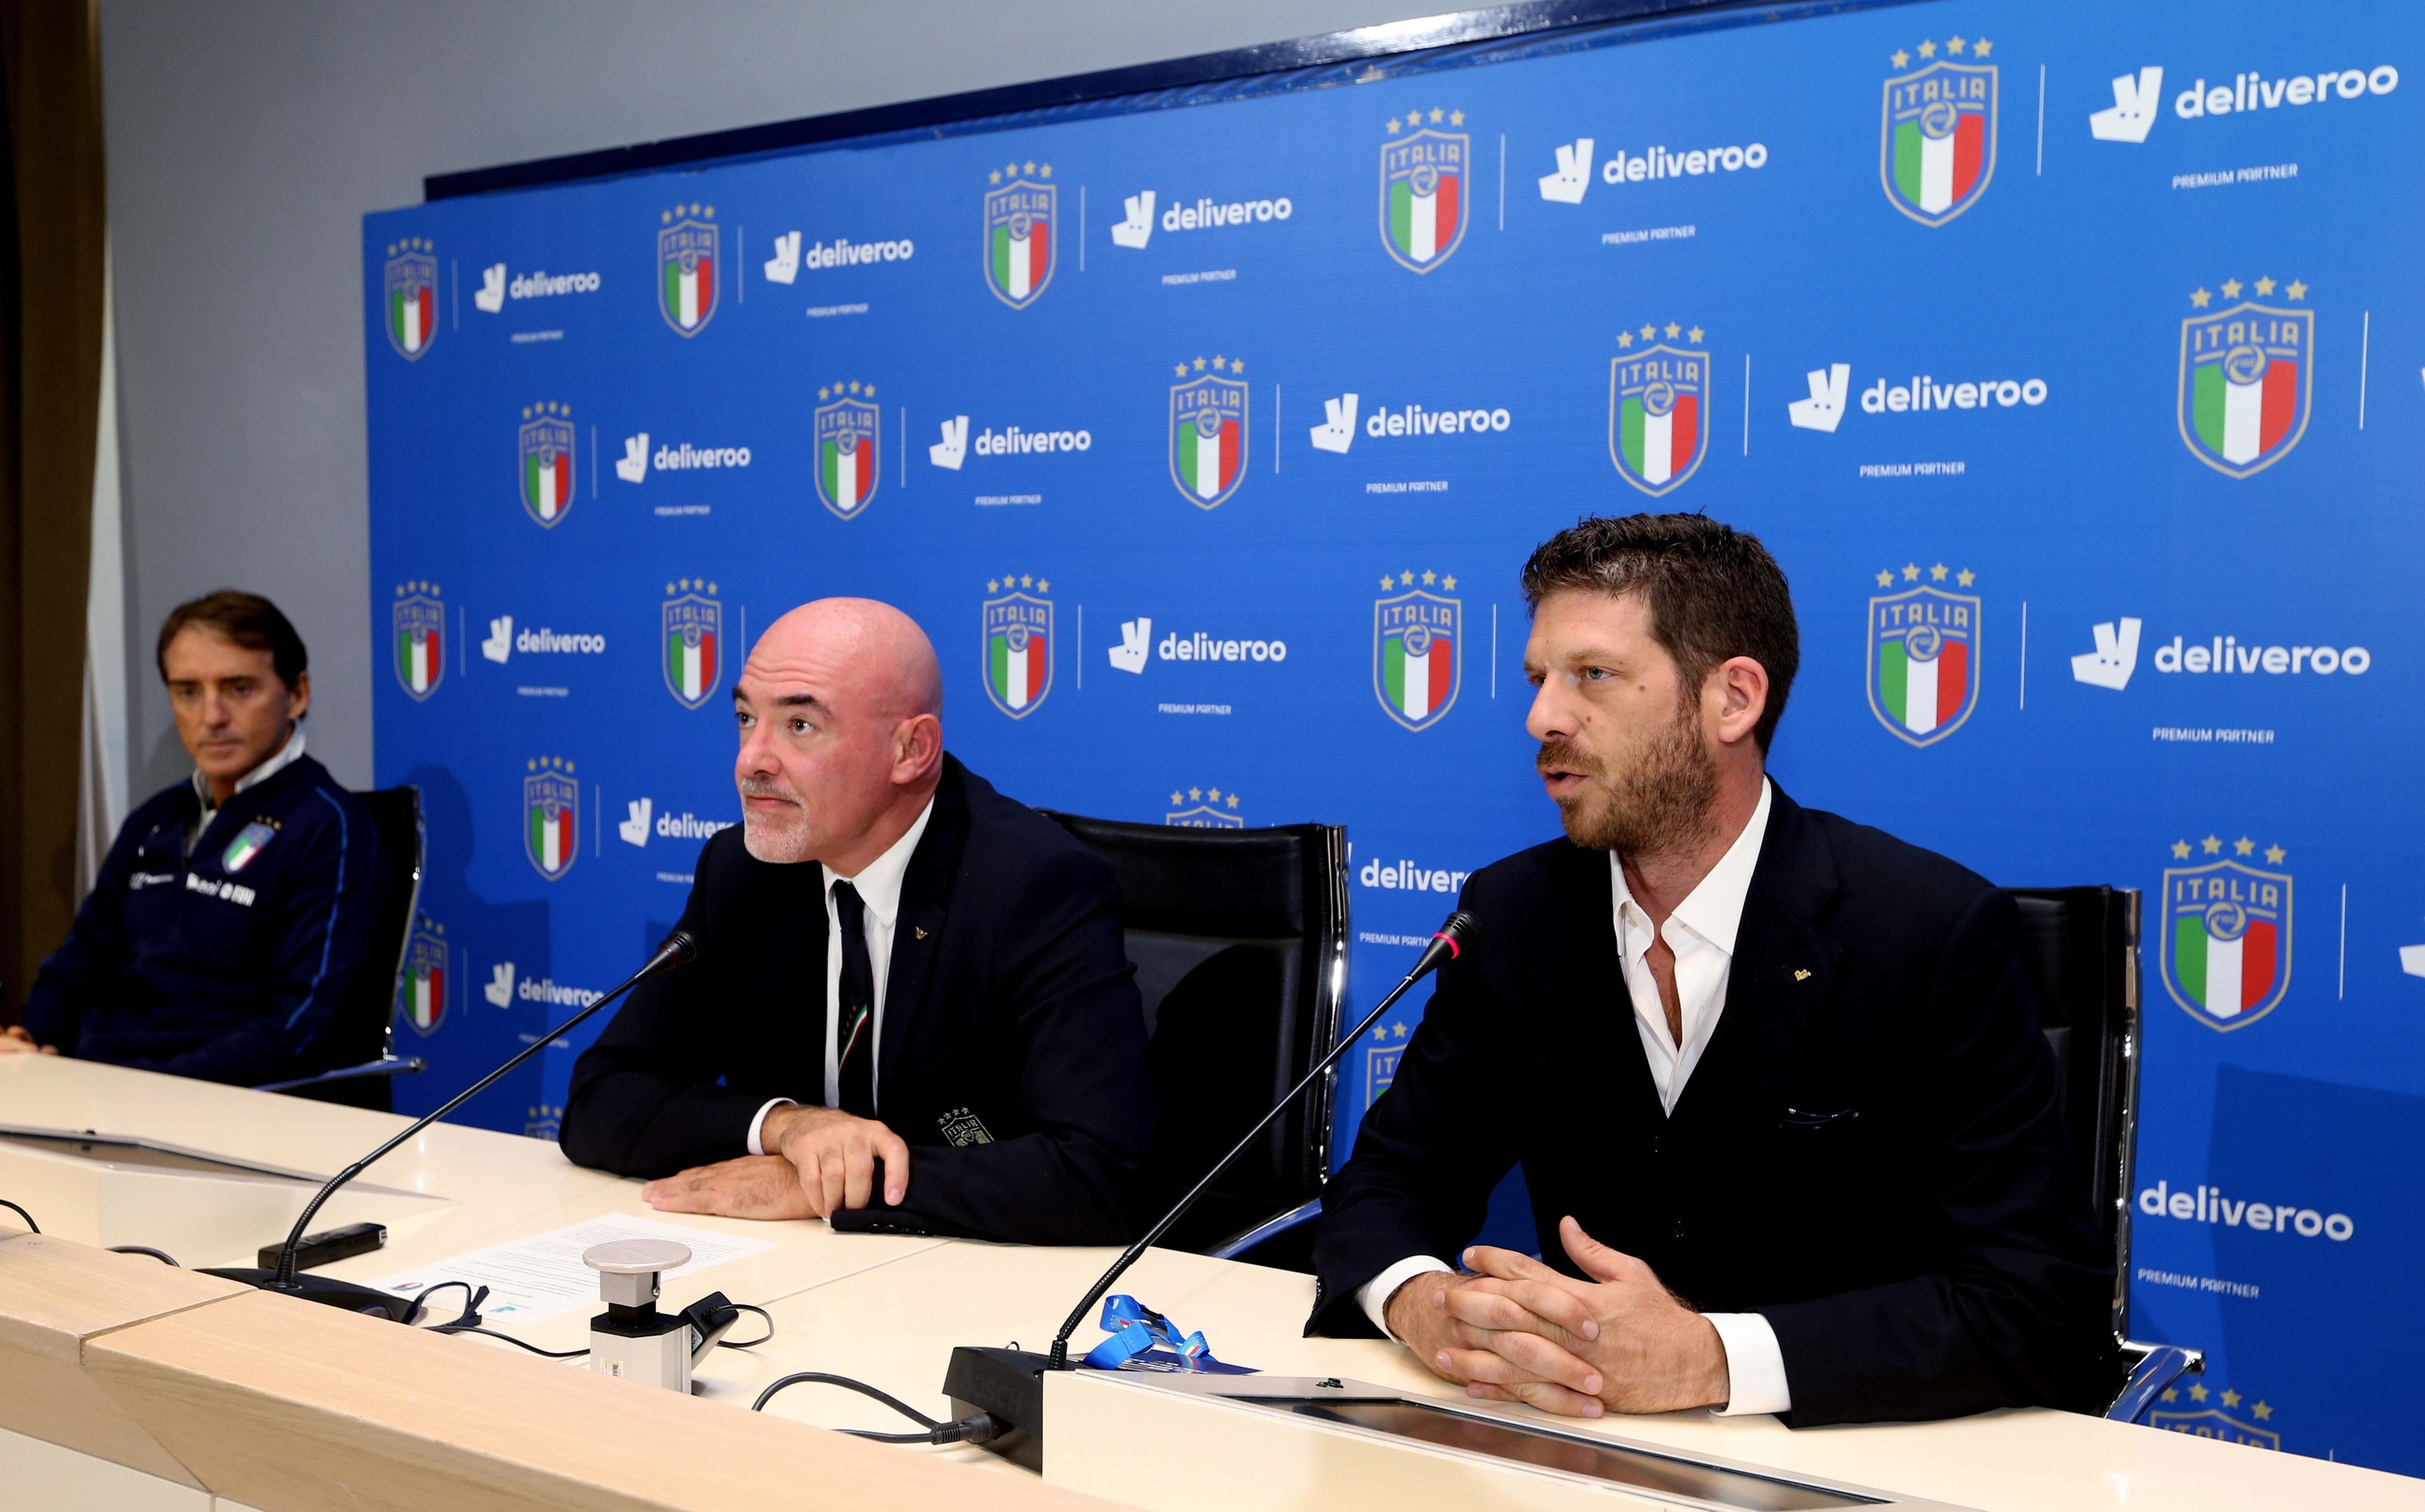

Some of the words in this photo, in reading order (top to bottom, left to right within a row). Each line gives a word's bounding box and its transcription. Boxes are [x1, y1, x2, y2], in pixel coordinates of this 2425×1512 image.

[1895, 76, 1985, 109] ITALIA
[2176, 66, 2398, 119] deliveroo
[1389, 143, 1459, 170] ITALIA
[1603, 143, 1767, 184] deliveroo
[2172, 170, 2234, 189] PREMIUM
[2237, 164, 2297, 182] PARTNER
[992, 194, 1048, 216] ITALIA
[1163, 198, 1292, 231] deliveroo
[664, 232, 713, 251] ITALIA
[1602, 230, 1649, 244] PREMIUM
[1650, 225, 1696, 239] PARTNER
[806, 239, 914, 269] deliveroo
[510, 271, 600, 299] deliveroo
[1161, 273, 1199, 285] PREMIUM
[1200, 269, 1236, 281] PARTNER
[2194, 319, 2299, 352] ITALIA
[1620, 360, 1699, 385] ITALIA
[1178, 388, 1240, 411] ITALIA
[1861, 376, 2047, 414] deliveroo
[822, 411, 871, 430] ITALIA
[1367, 405, 1510, 437] deliveroo
[975, 427, 1091, 455] deliveroo
[654, 444, 751, 470] deliveroo
[1860, 464, 1912, 477] PREMIUM
[1914, 462, 1965, 475] PARTNER
[974, 496, 1008, 506] PREMIUM
[1009, 494, 1042, 504] PARTNER
[1367, 482, 1407, 493] PREMIUM
[1408, 481, 1448, 491] PARTNER
[669, 605, 715, 624] ITALIA
[990, 606, 1046, 625] ITALIA
[1384, 605, 1452, 627] ITALIA
[1880, 603, 1968, 629] ITALIA
[517, 628, 605, 653] deliveroo
[1159, 633, 1286, 662] deliveroo
[2155, 636, 2370, 674] deliveroo
[1158, 703, 1195, 713] PREMIUM
[1196, 704, 1231, 715] PARTNER
[2153, 728, 2212, 741] PREMIUM
[2215, 729, 2274, 743] PARTNER
[657, 812, 735, 839] deliver
[1360, 858, 1470, 893] deliver
[2177, 877, 2278, 908] ITALIA
[1360, 932, 1399, 945] PREMIUM
[1401, 935, 1432, 947] PARTN
[947, 1119, 978, 1137] ITALIA
[2140, 1181, 2353, 1241] deliveroo
[2138, 1268, 2197, 1289] PREMIUM
[2201, 1278, 2259, 1297] PARTNER
